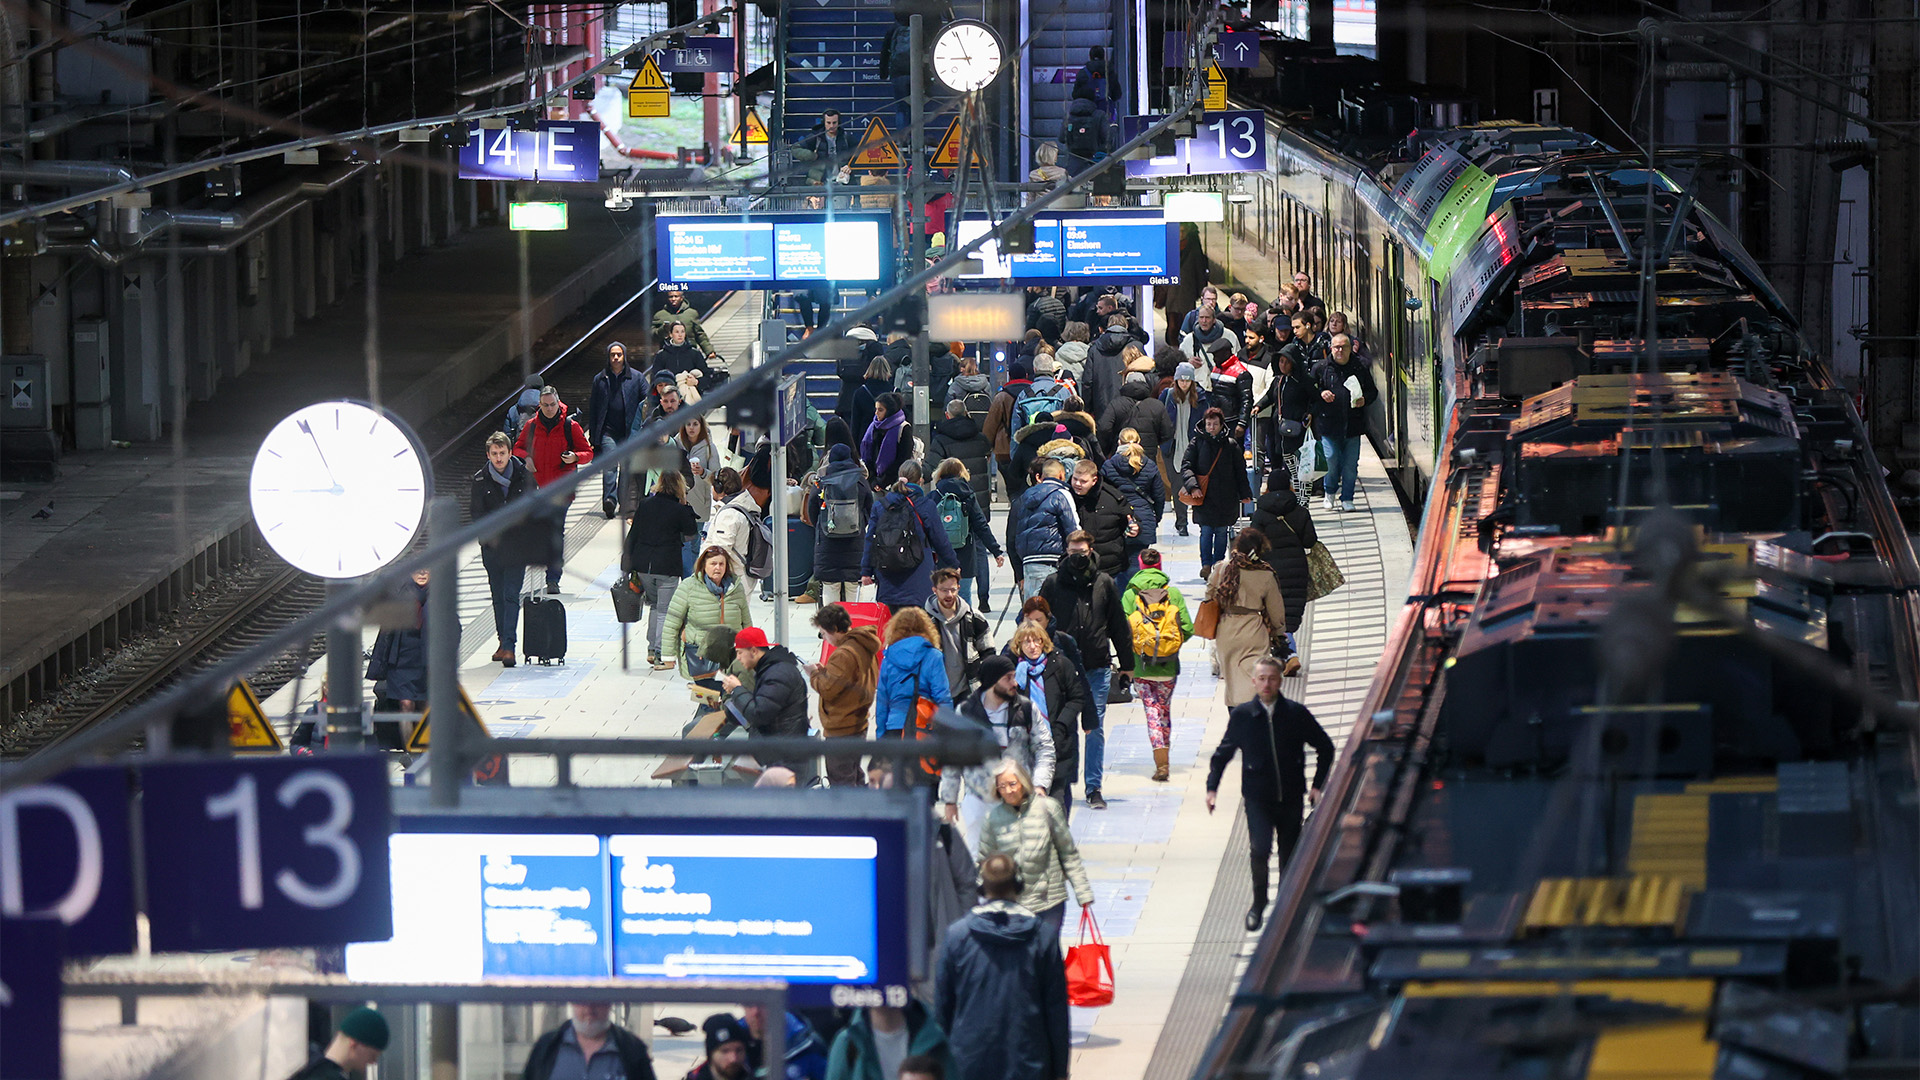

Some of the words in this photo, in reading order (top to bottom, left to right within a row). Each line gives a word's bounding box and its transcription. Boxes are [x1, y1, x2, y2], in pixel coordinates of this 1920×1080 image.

[1537, 92, 1555, 121] H
[470, 126, 516, 166] 14
[547, 127, 575, 171] E
[1209, 116, 1257, 159] 13
[659, 282, 679, 291] Gleis
[680, 282, 689, 291] 14
[1149, 276, 1169, 285] Gleis
[1171, 276, 1179, 285] 13
[0, 783, 103, 926] D
[205, 770, 362, 909] 13
